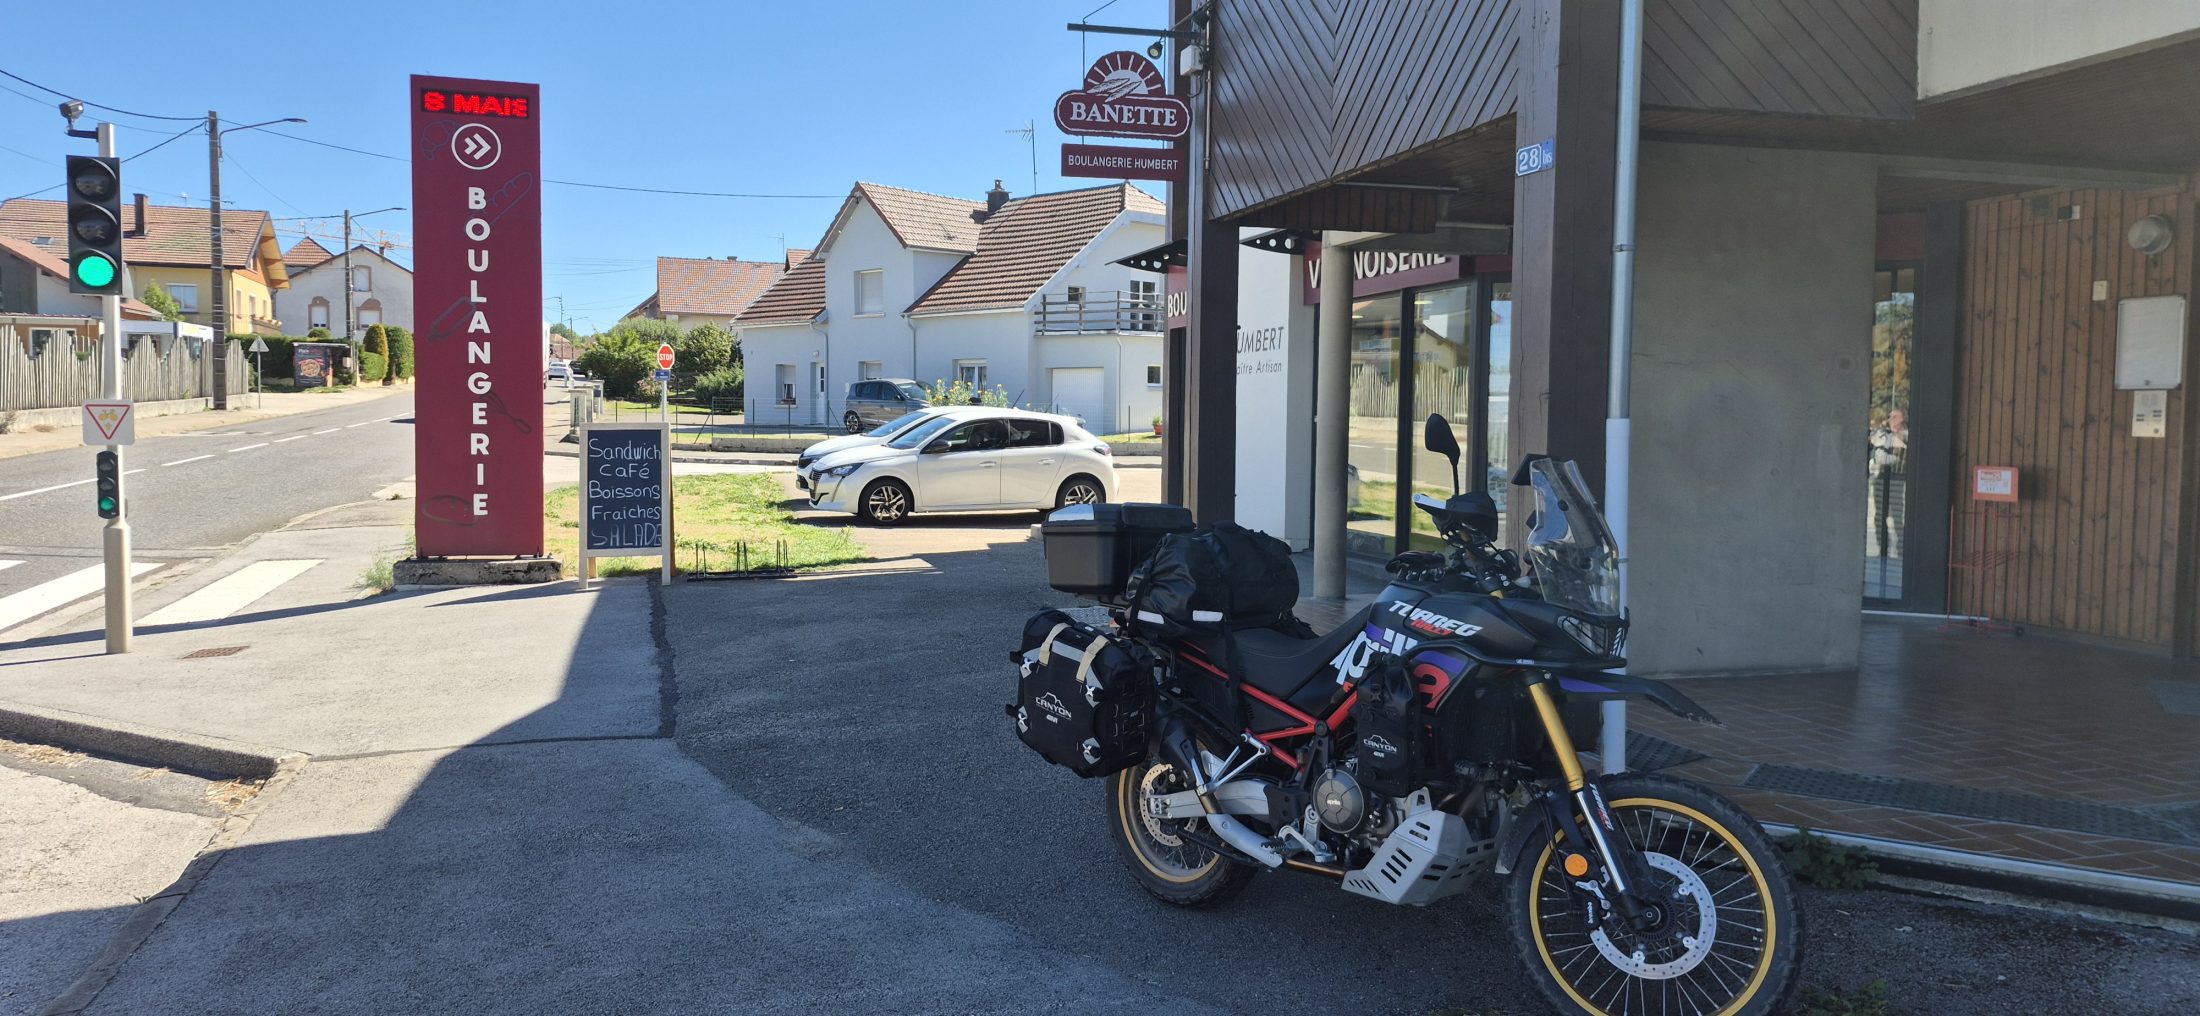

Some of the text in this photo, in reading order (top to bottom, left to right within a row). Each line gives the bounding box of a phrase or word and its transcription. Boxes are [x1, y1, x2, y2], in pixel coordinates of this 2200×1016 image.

[1070, 102, 1178, 127] BANETTE
[1068, 154, 1178, 171] BOULANGERIE HUMBERT
[1519, 148, 1539, 172] 28
[465, 186, 492, 516] BOULANGERIE
[1237, 326, 1285, 354] UMBERT
[660, 353, 673, 361] STOP
[1256, 360, 1282, 374] Artisan
[588, 438, 661, 460] Sandwich
[589, 480, 661, 499] Boissons
[1389, 600, 1483, 637] TUAREG
[1036, 696, 1072, 719] CANYON
[1363, 738, 1397, 753] CANYON
